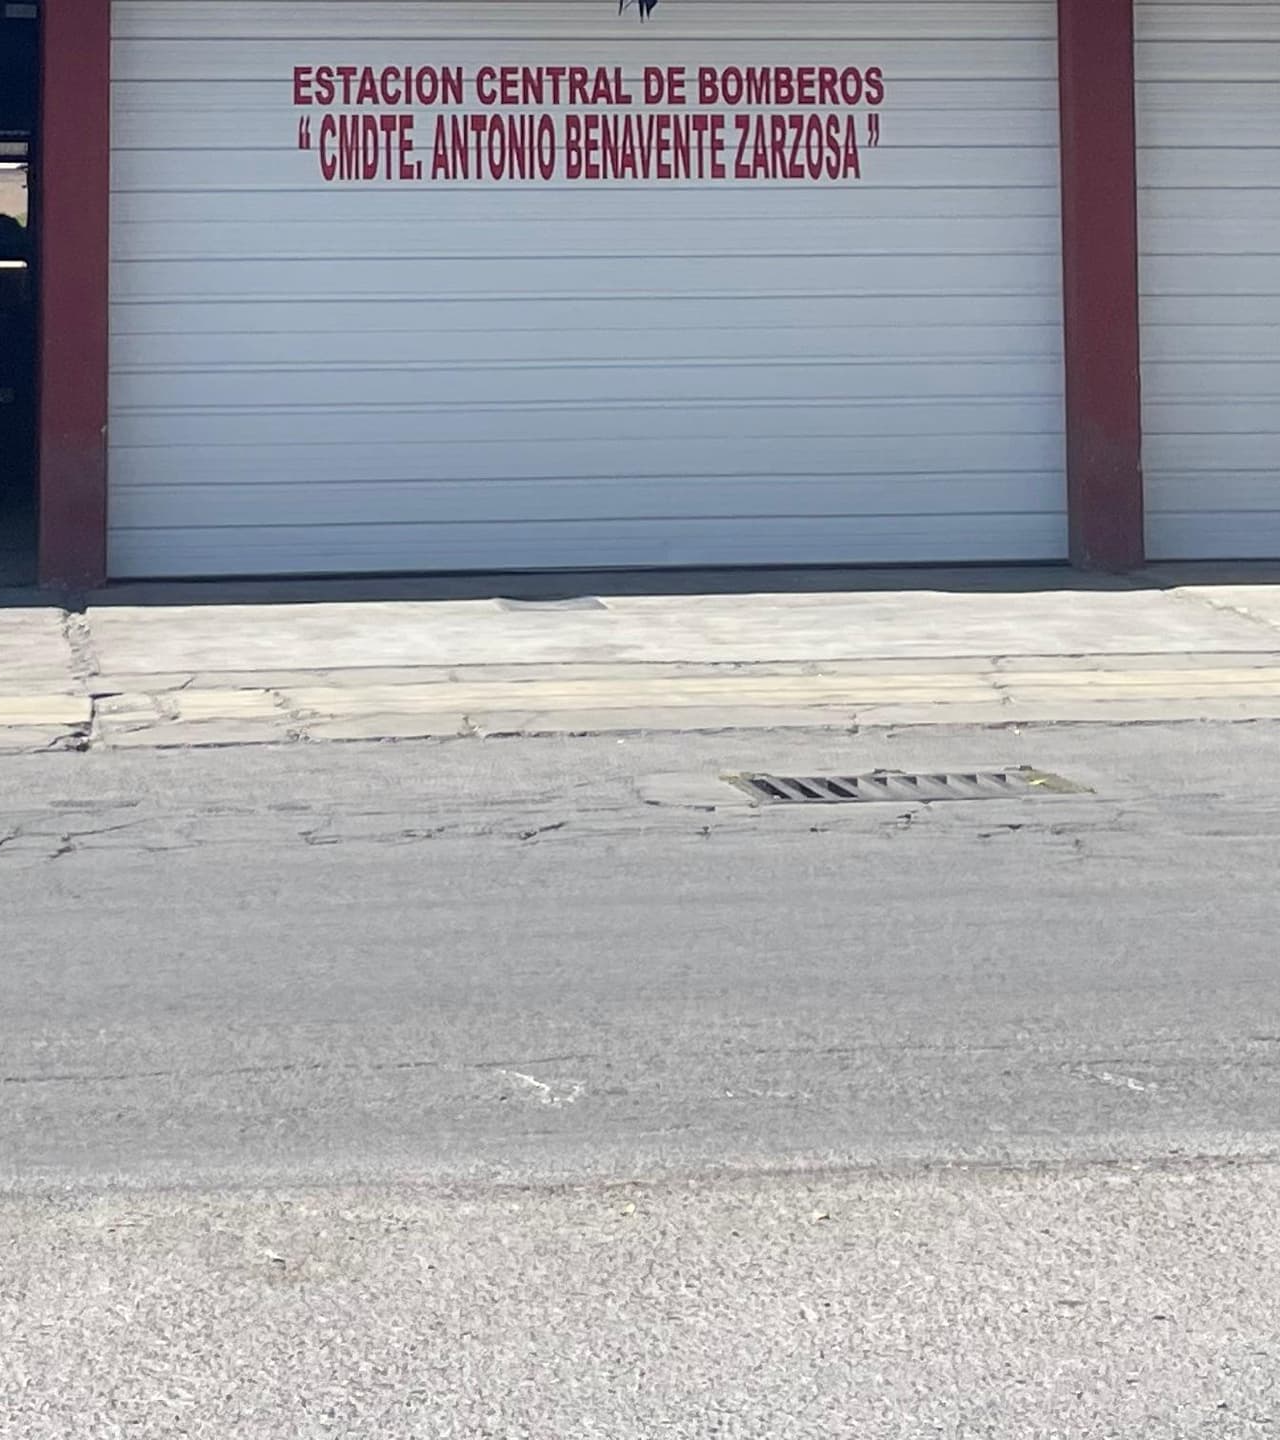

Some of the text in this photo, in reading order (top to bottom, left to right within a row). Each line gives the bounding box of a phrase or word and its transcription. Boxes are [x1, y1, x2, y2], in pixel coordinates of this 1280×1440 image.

[292, 65, 885, 106] ESTACION CENTRAL DE BOMBEROS
[430, 113, 556, 181] ANTONIO
[564, 113, 726, 180] BENAVENTE
